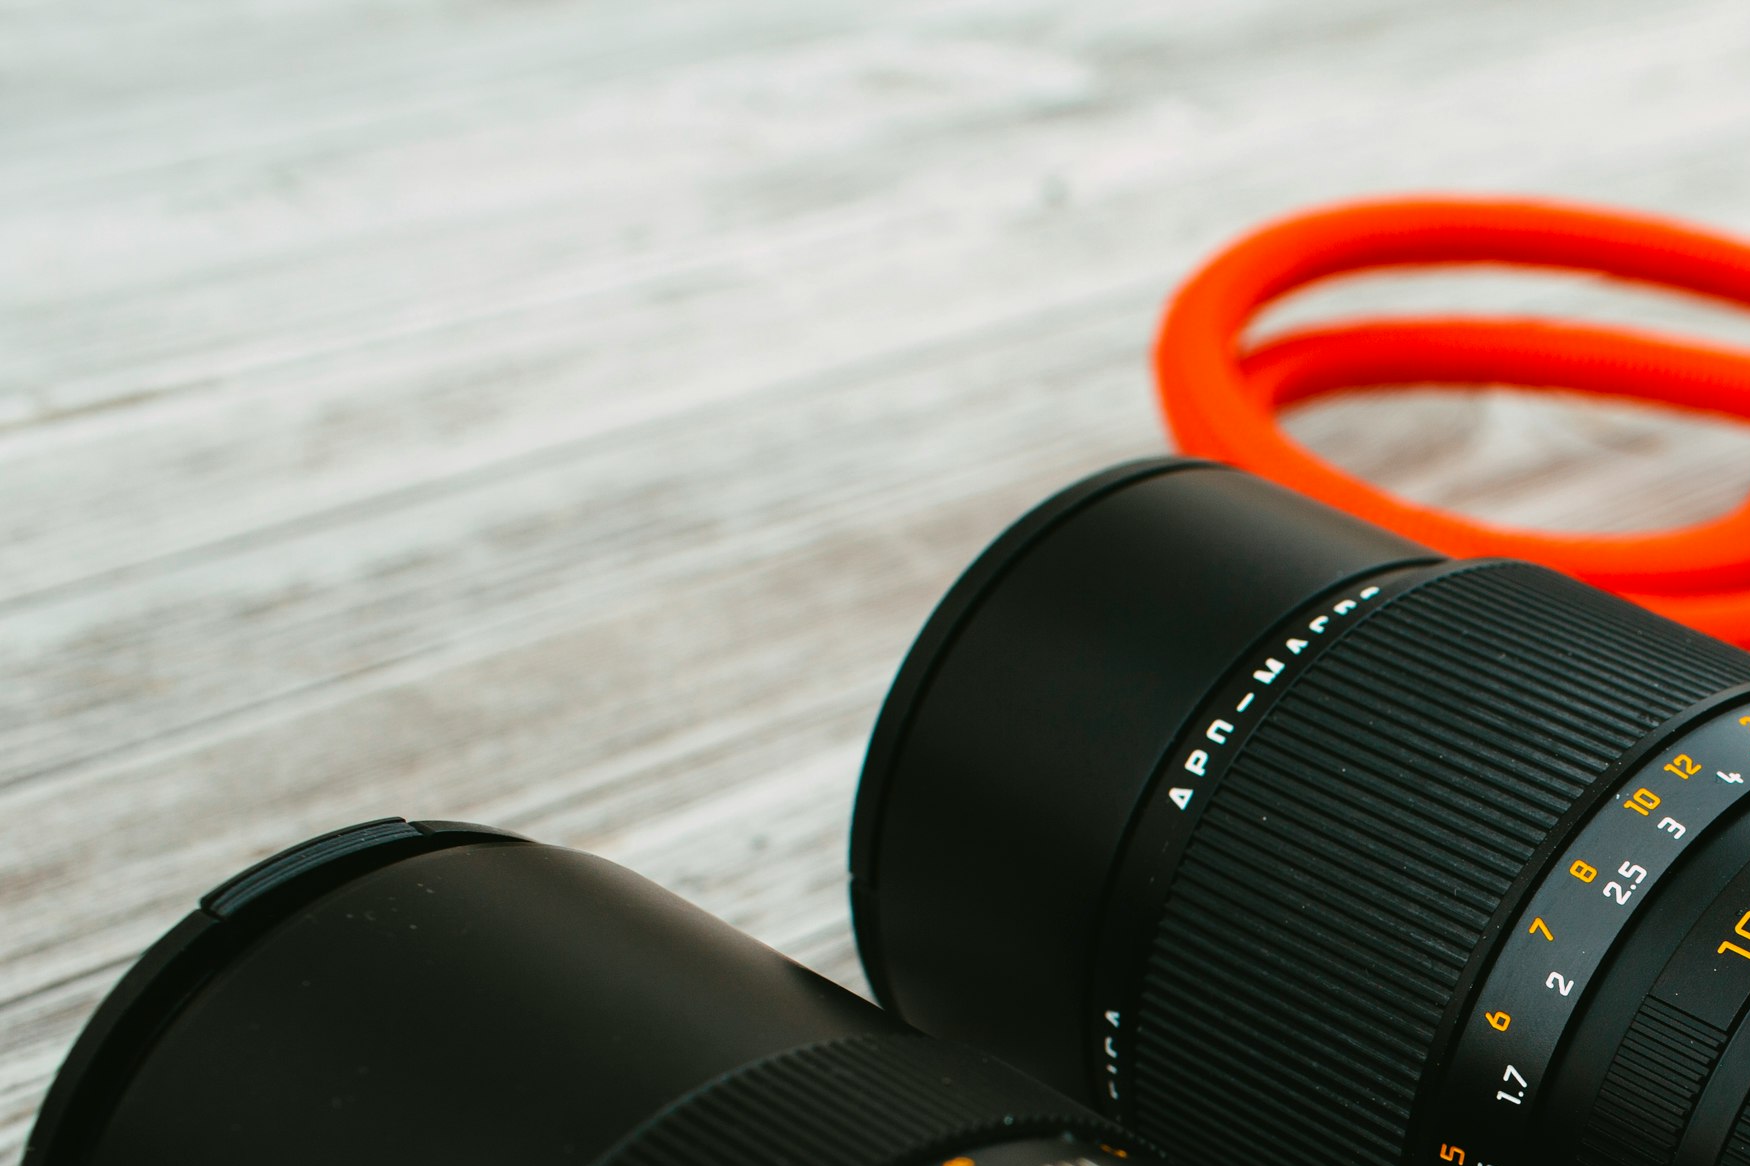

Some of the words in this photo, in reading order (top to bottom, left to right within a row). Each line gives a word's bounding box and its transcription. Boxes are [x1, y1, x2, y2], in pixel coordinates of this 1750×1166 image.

[1440, 1144, 1465, 1165] 5
[1485, 1011, 1511, 1031] 6
[1529, 917, 1554, 941] 7
[1570, 860, 1598, 883] 8
[1624, 787, 1661, 816] 10
[1663, 753, 1702, 780] 12
[1496, 1064, 1528, 1105] 1.7
[1546, 971, 1575, 996] 2
[1603, 860, 1648, 905] 2.5
[1657, 816, 1686, 839] 3
[1716, 770, 1744, 783] 4
